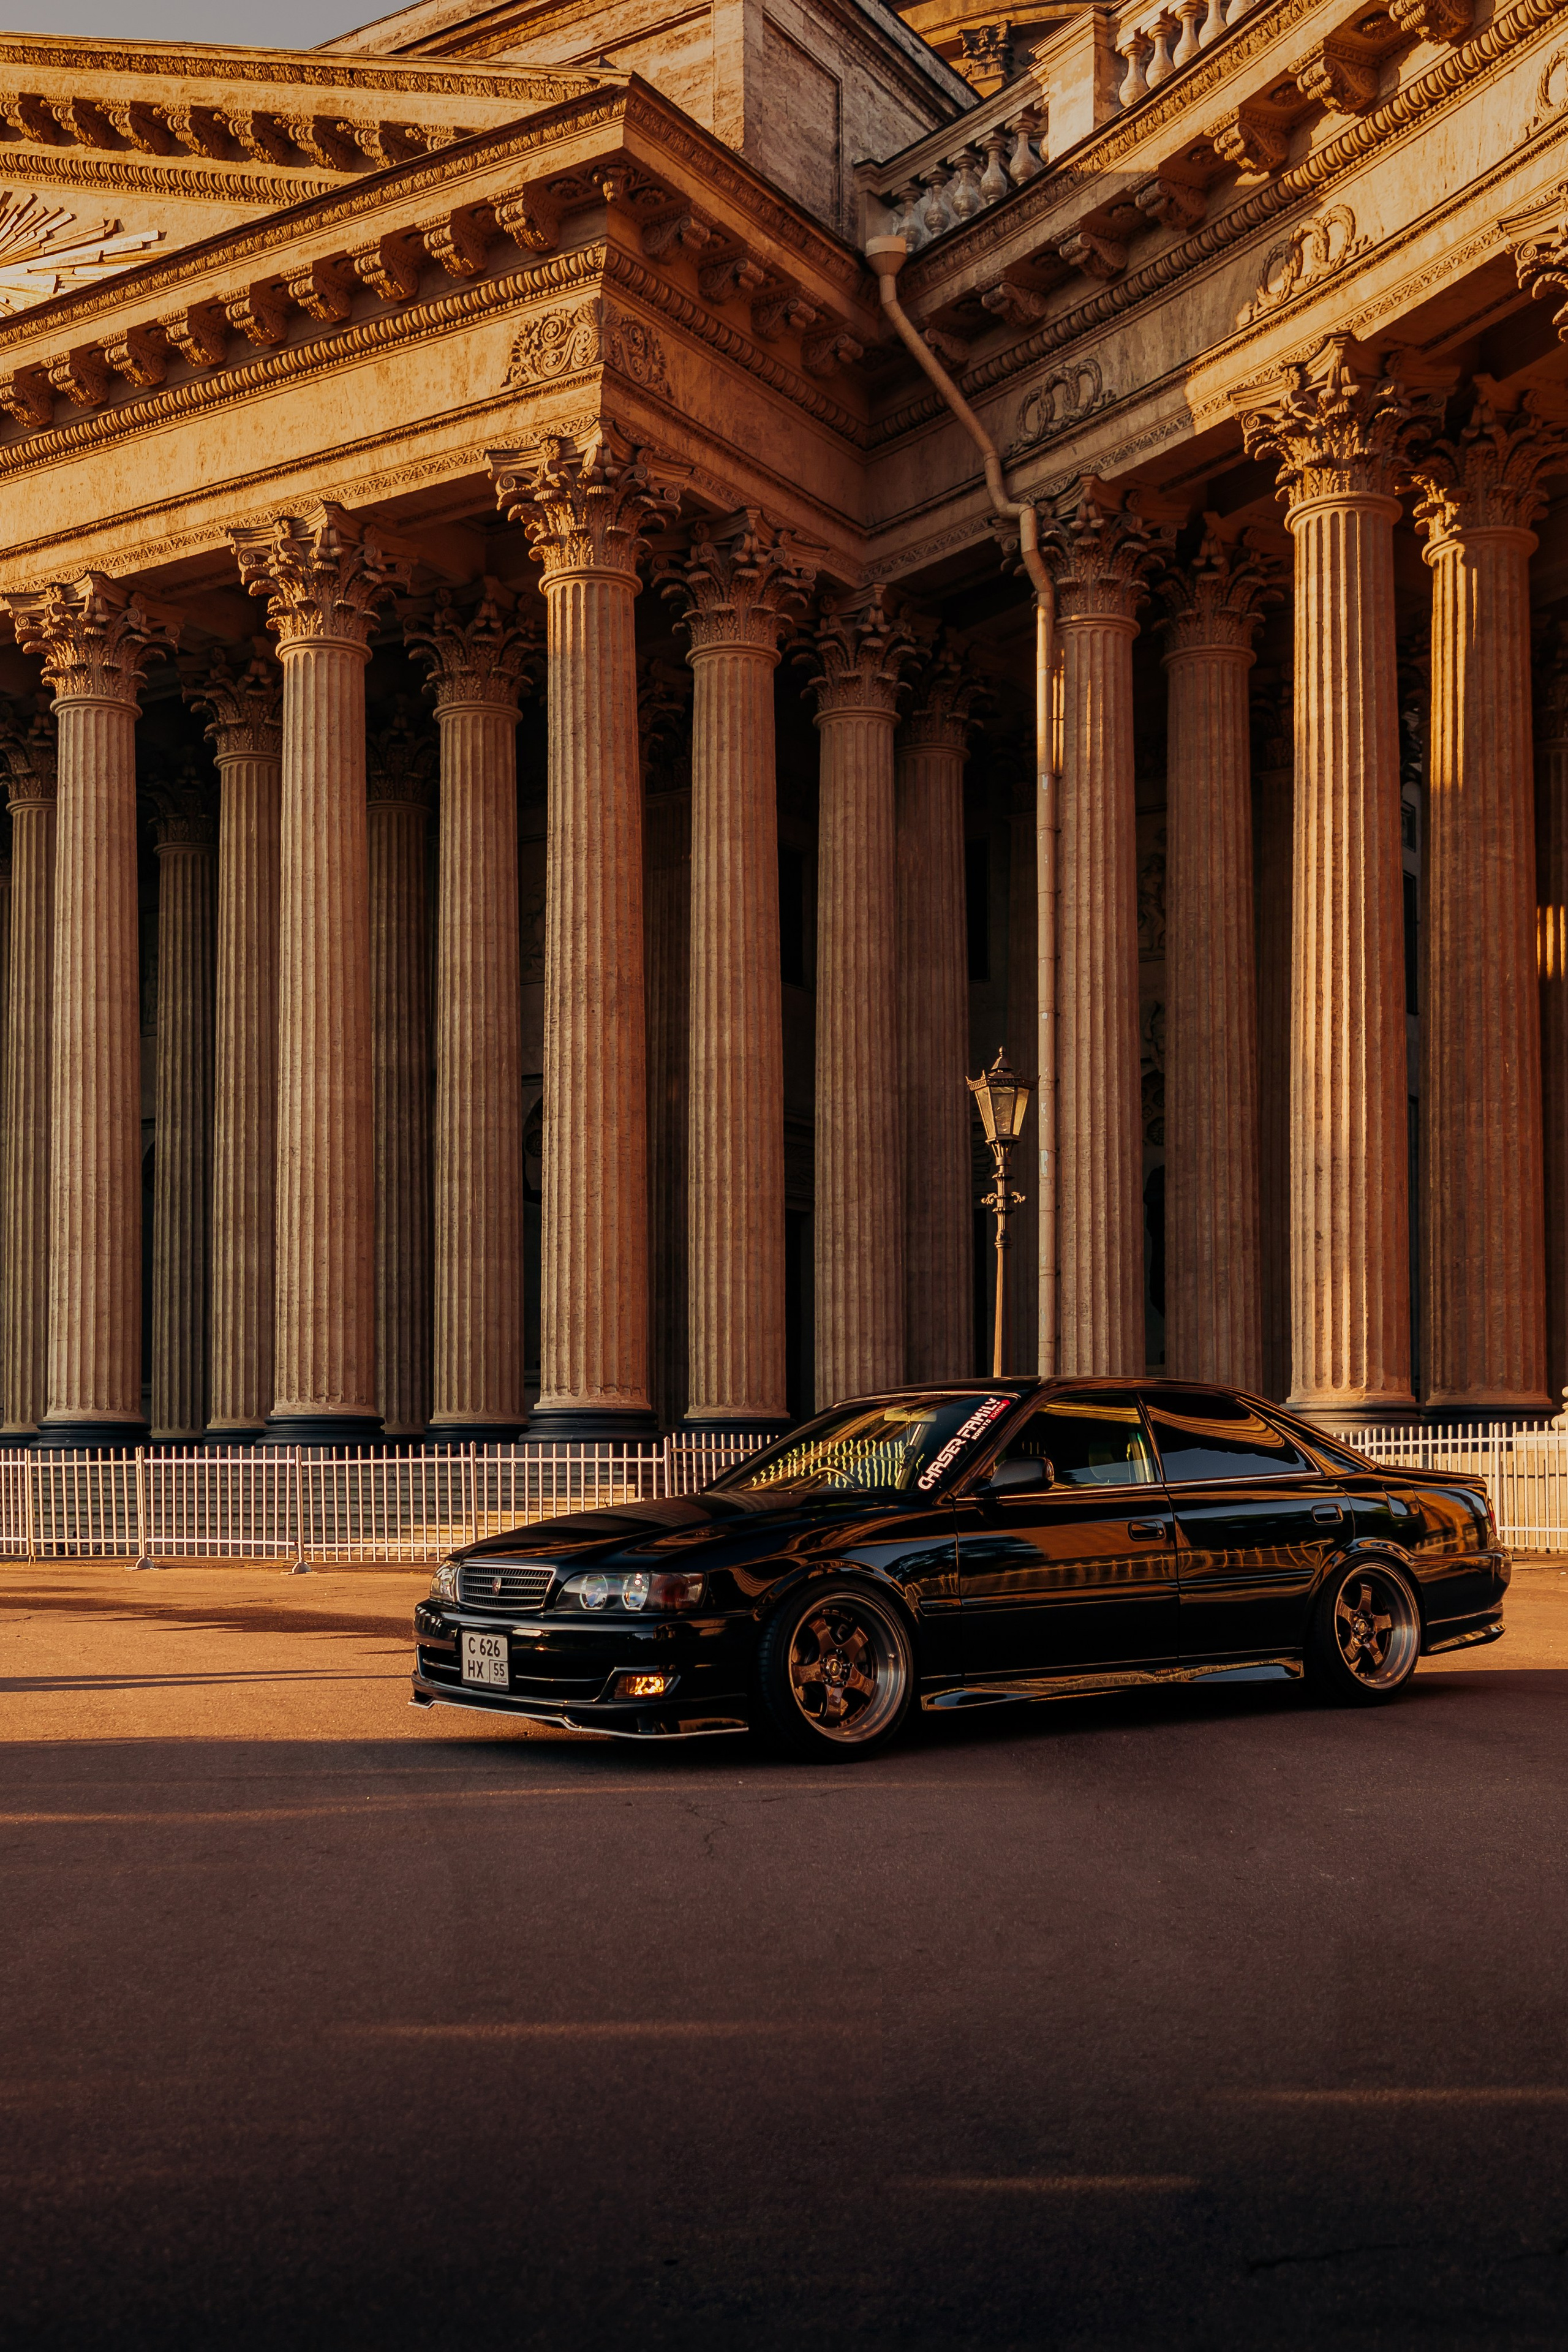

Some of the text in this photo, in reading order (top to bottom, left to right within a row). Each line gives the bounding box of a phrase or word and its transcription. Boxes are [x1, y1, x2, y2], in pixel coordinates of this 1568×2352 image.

[971, 1425, 986, 1440] BORN
[990, 1403, 1006, 1418] CHASE
[918, 1438, 967, 1490] CHASER
[468, 1636, 500, 1657] C 626
[467, 1659, 505, 1679] HX 55
